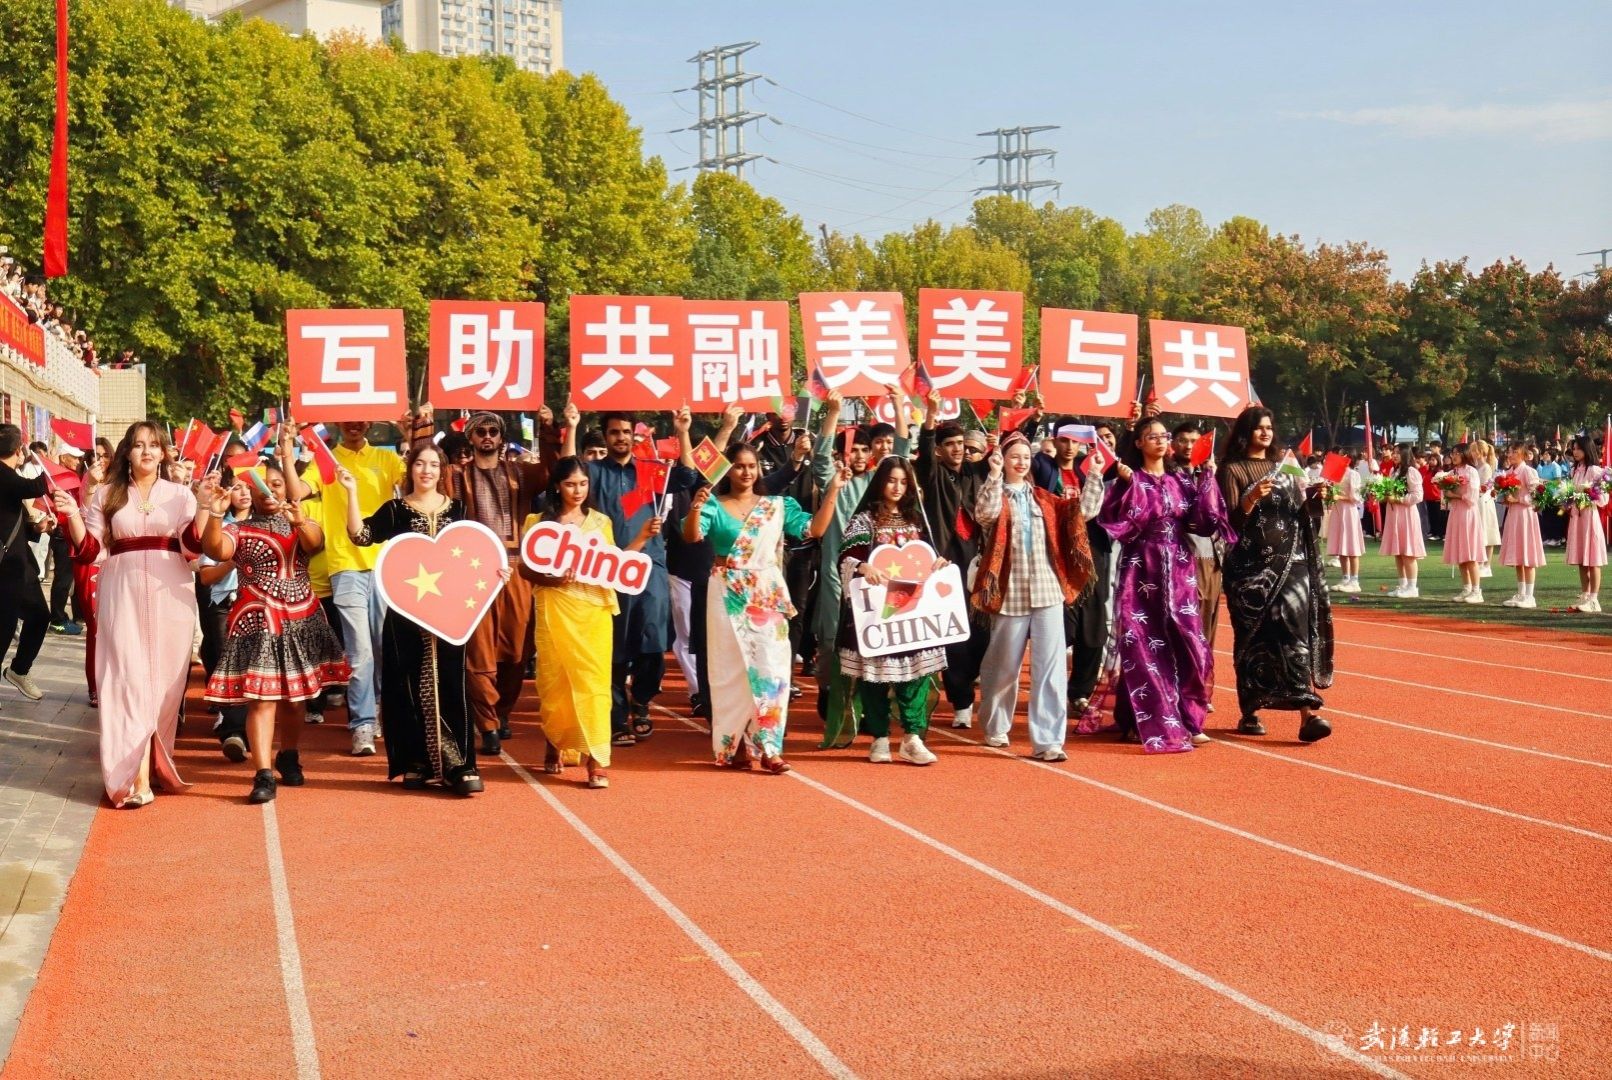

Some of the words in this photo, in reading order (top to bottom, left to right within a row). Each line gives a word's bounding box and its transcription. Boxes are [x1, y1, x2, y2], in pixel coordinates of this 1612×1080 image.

[525, 528, 648, 590] China
[859, 587, 874, 613] I
[862, 611, 967, 650] CHINA
